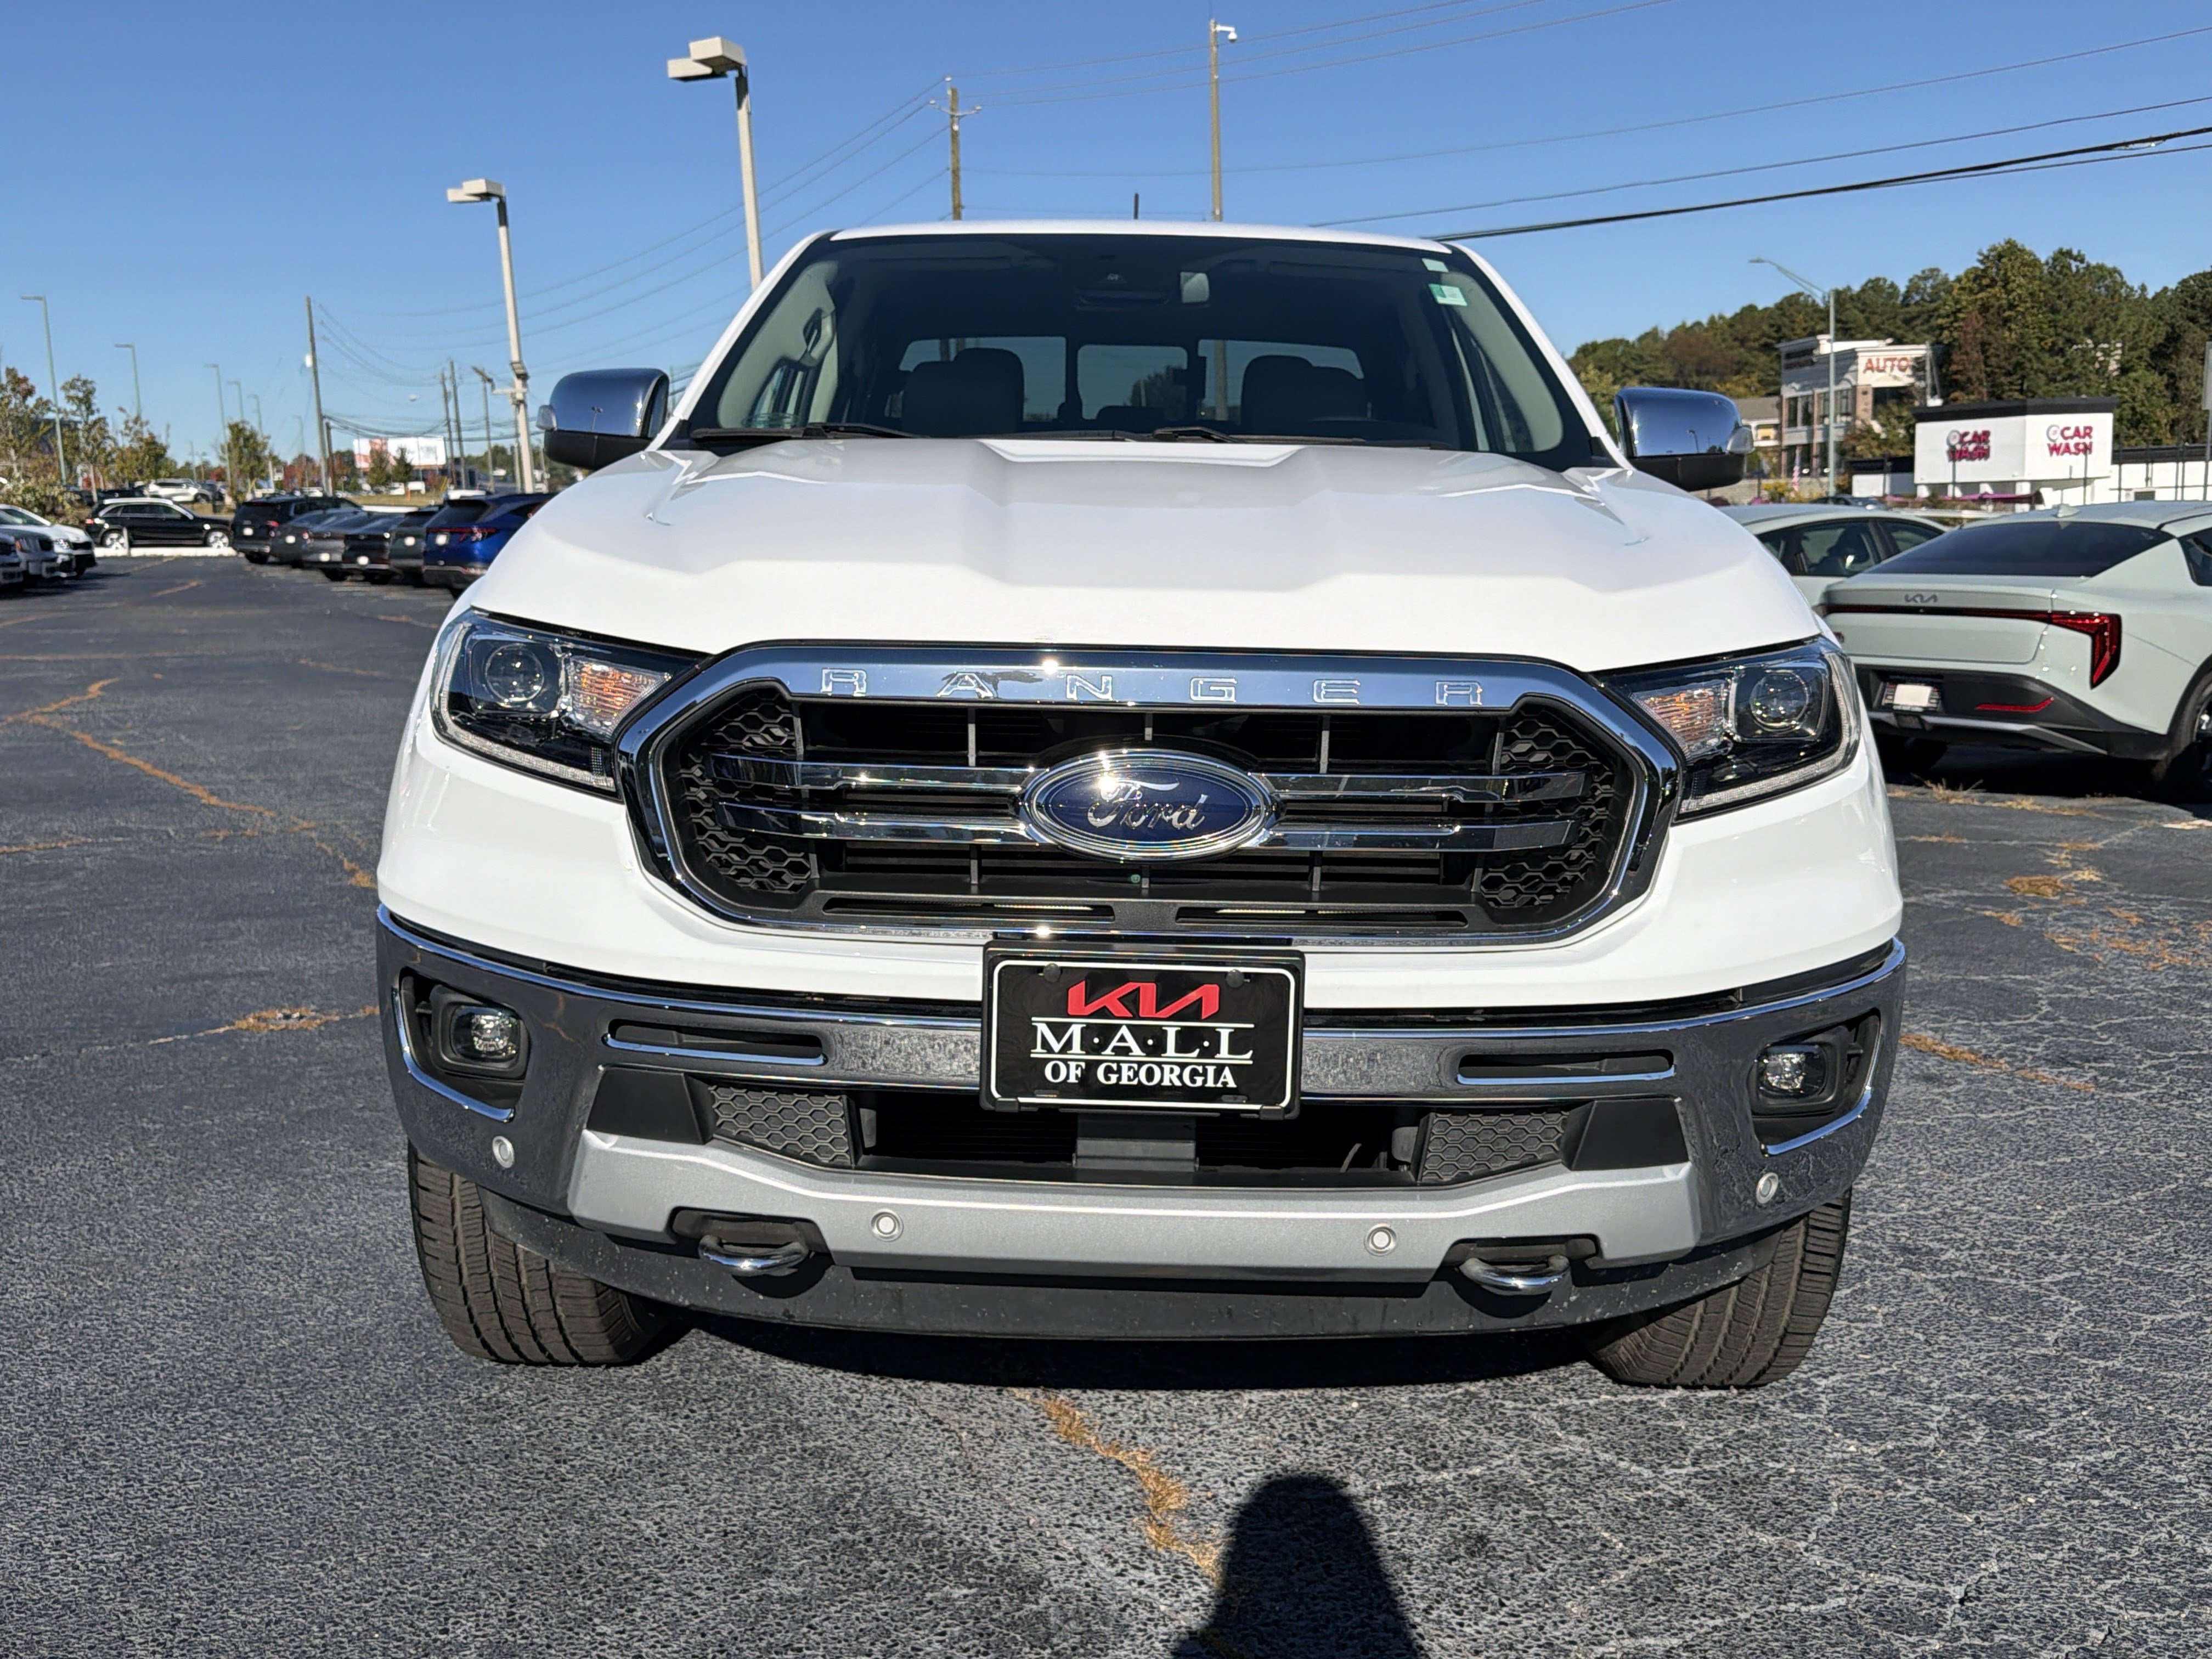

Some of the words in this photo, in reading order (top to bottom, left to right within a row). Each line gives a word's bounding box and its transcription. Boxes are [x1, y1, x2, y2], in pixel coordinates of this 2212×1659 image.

[1864, 356, 1910, 373] AUTO
[1960, 430, 1990, 446] CAR
[2060, 425, 2093, 440] CAR
[1946, 445, 1990, 462] WASH
[2046, 441, 2093, 457] WASH
[821, 667, 1482, 706] RANGER
[1087, 776, 1209, 830] Ford
[1068, 980, 1220, 1020] KIA
[1045, 1060, 1086, 1084] OF
[1097, 1062, 1238, 1088] GEORGIA
